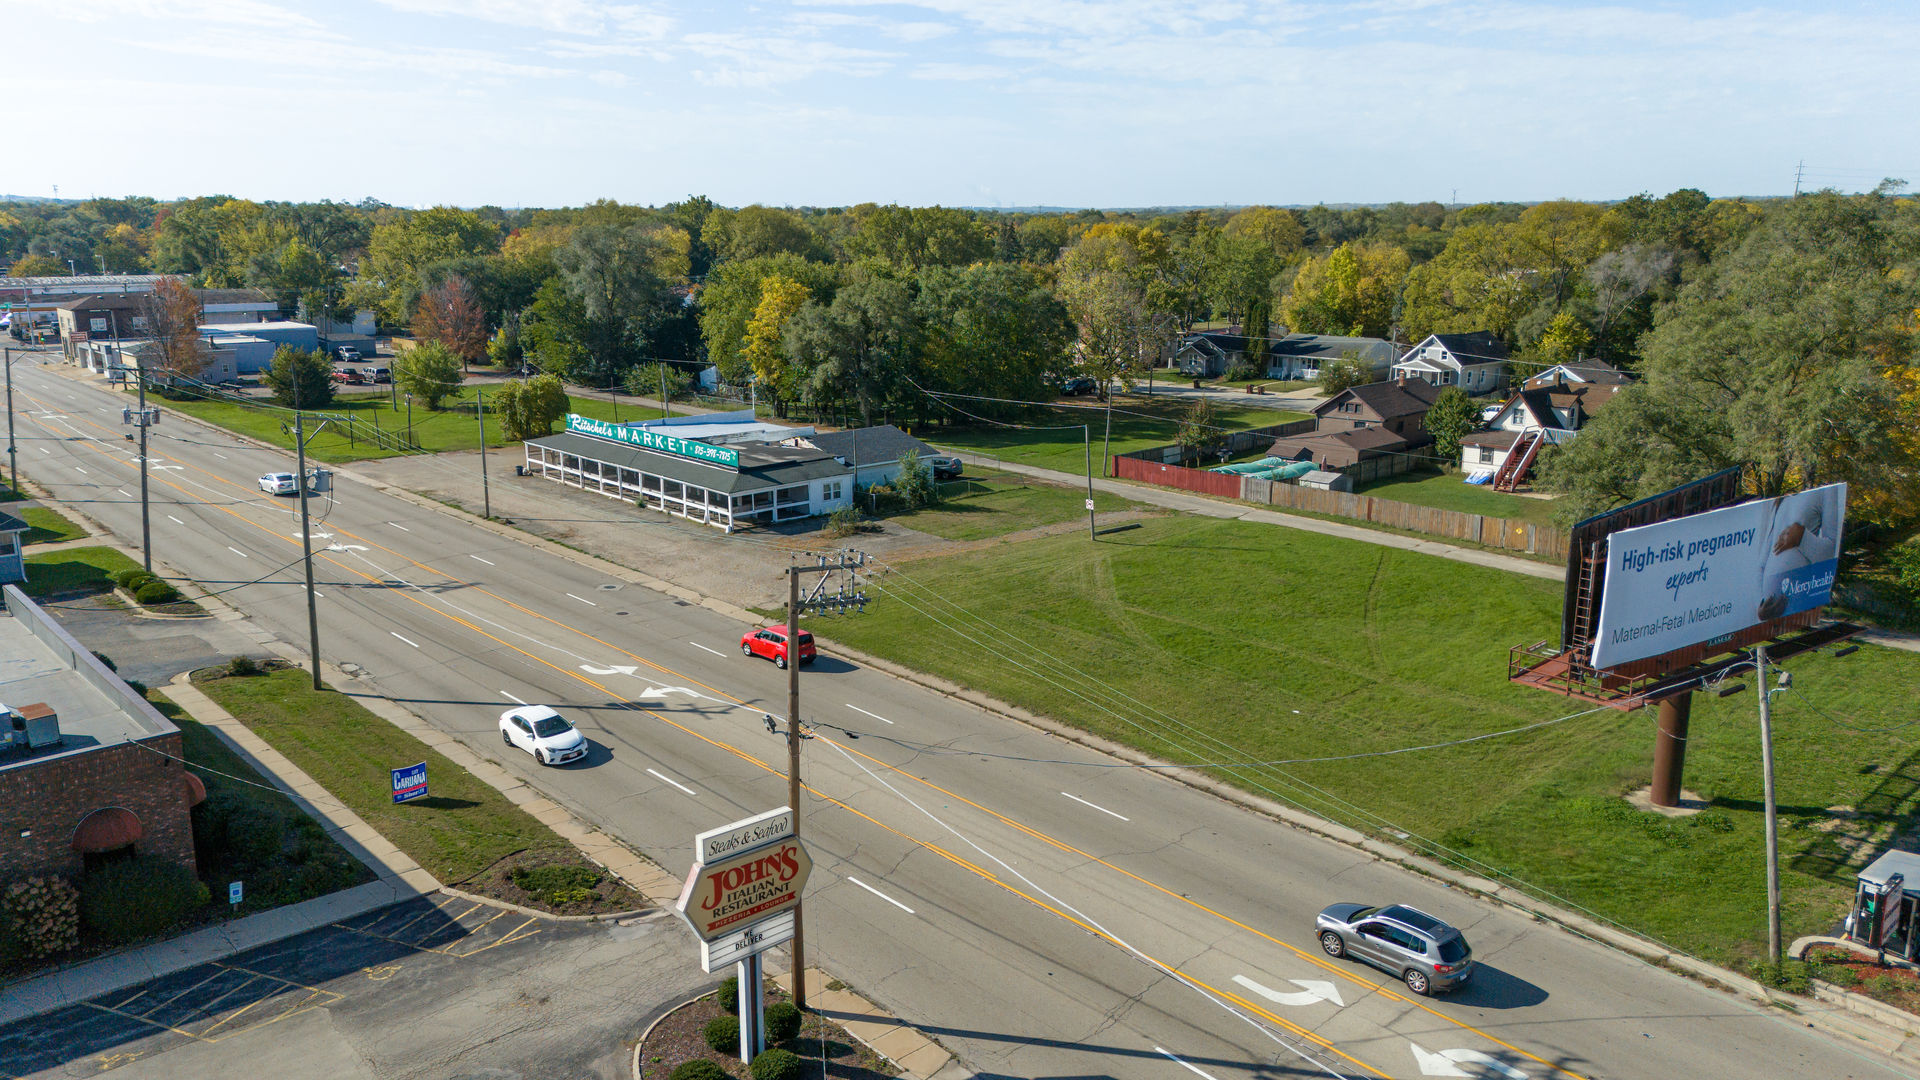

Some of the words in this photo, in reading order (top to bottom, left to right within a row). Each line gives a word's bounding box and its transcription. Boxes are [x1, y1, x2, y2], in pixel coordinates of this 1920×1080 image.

[571, 413, 613, 437] Ritschel's
[617, 427, 689, 453] MARKET
[1622, 540, 1683, 572] High-risk
[1687, 528, 1756, 561] pregnancy
[1665, 560, 1709, 601] experts
[1788, 570, 1834, 596] Mercyhealth
[1611, 612, 1686, 645] Maternal-Fetal
[1689, 600, 1732, 624] Medicine
[708, 834, 740, 857] Steaks
[741, 831, 751, 844] &
[752, 817, 788, 842] Seafood
[701, 845, 799, 911] JOHN'S
[727, 878, 775, 903] ITALIAN
[713, 882, 791, 918] RESTAURANT
[715, 910, 751, 927] PIZZERIA
[760, 895, 789, 910] LOUNGE
[735, 933, 763, 951] DELIVER
[743, 929, 753, 940] WE
